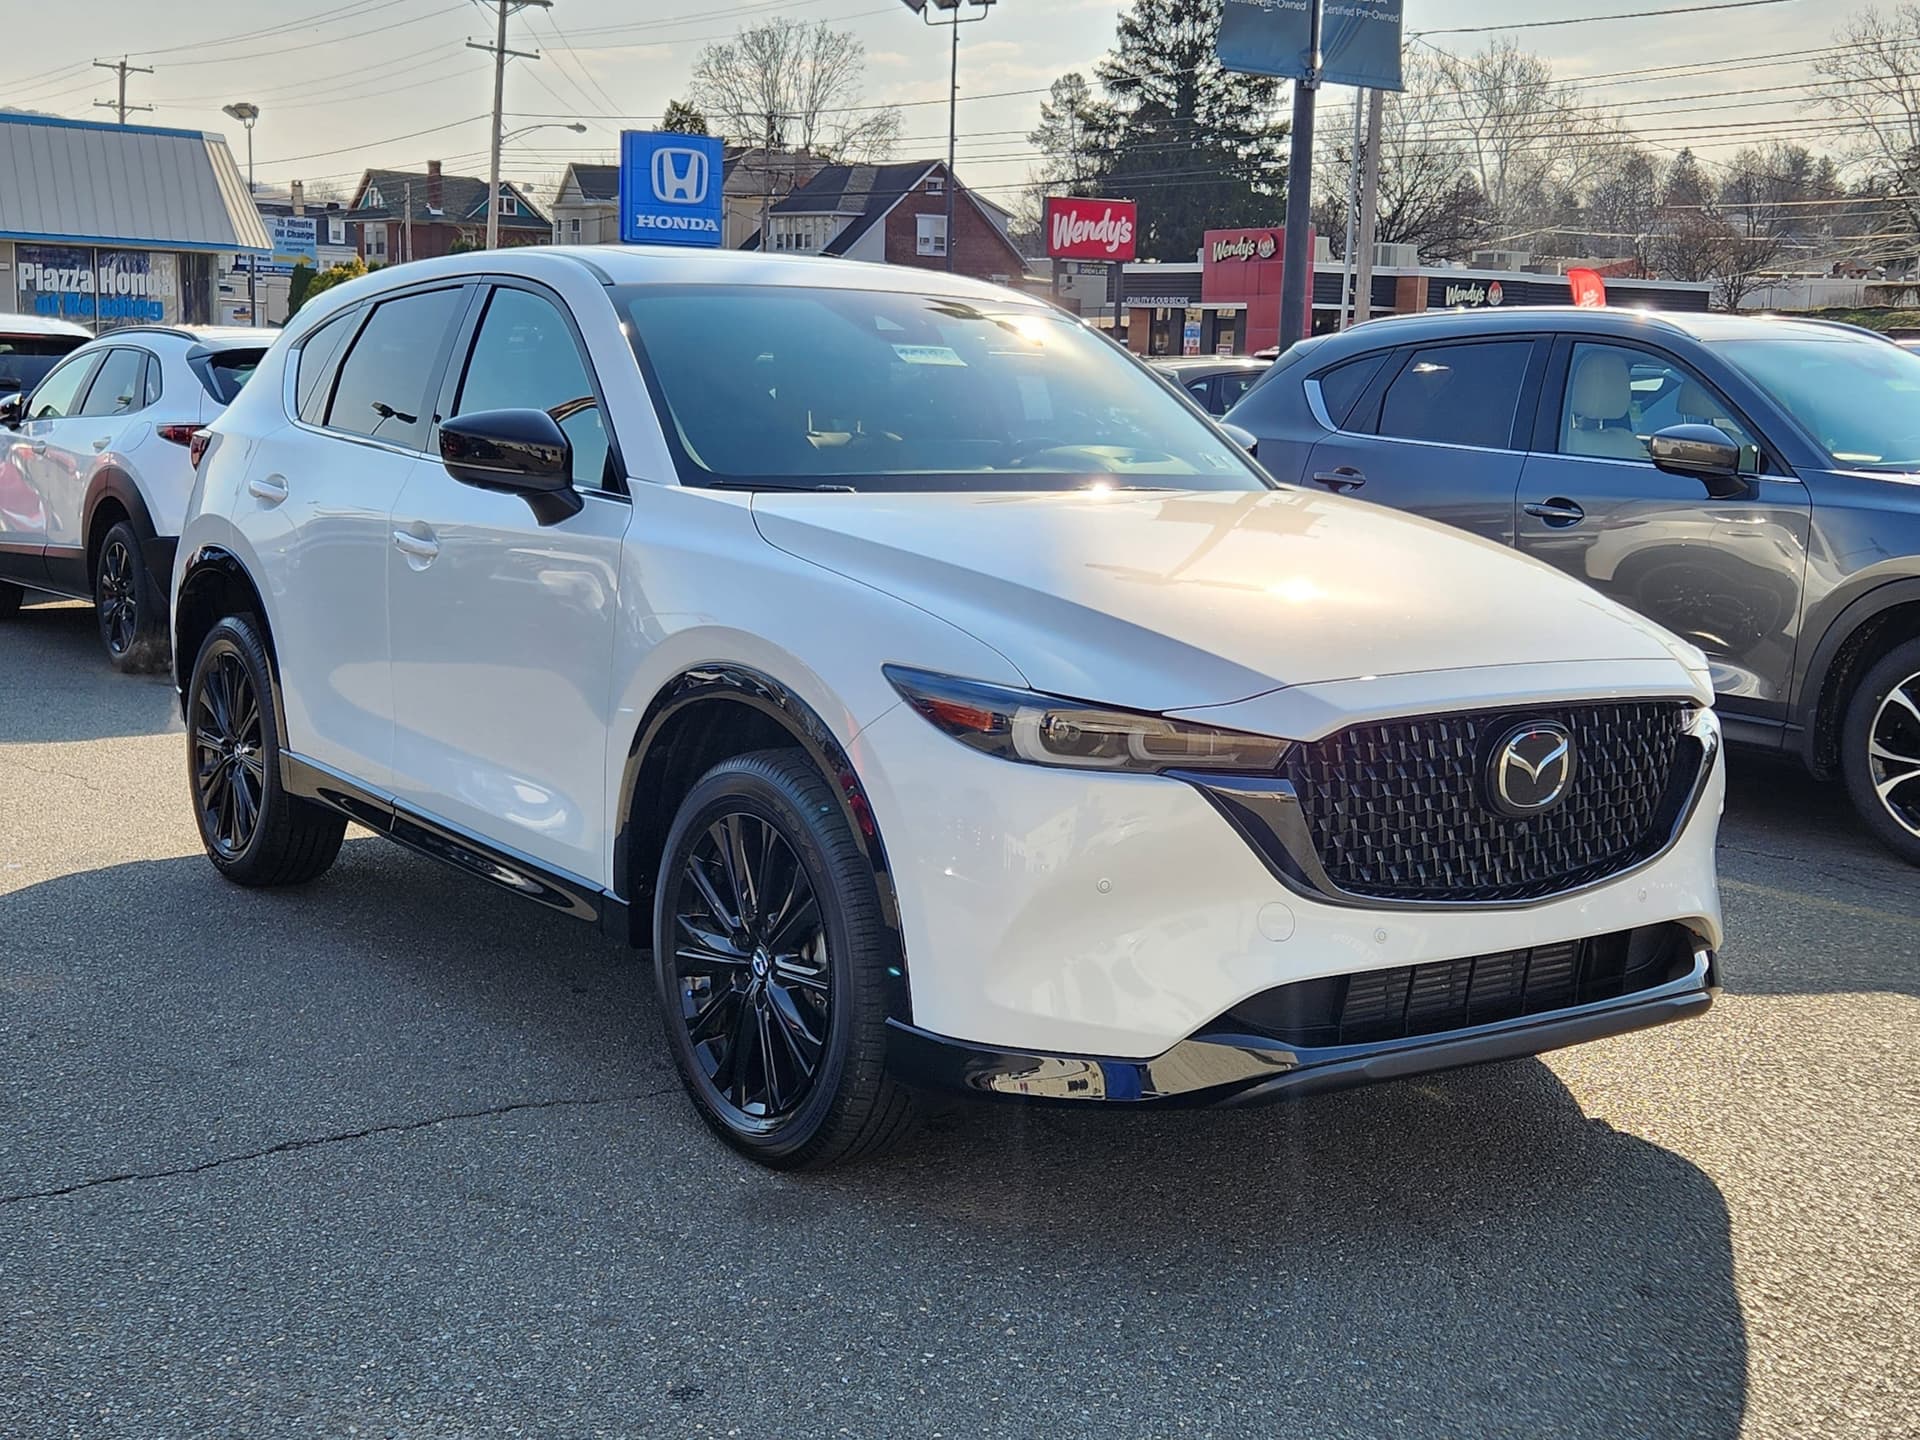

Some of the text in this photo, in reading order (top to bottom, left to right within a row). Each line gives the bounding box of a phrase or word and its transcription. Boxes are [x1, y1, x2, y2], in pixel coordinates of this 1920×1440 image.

[1356, 8, 1400, 23] Pre-Owned
[636, 214, 719, 232] HONDA
[1053, 208, 1133, 252] Wendy's
[287, 230, 315, 240] Change
[1212, 236, 1256, 262] Wendy's
[18, 262, 176, 297] Piazza Honda
[1126, 296, 1149, 305] QUALITY
[1169, 297, 1189, 305] RECIPE
[1445, 282, 1485, 307] Wendy's
